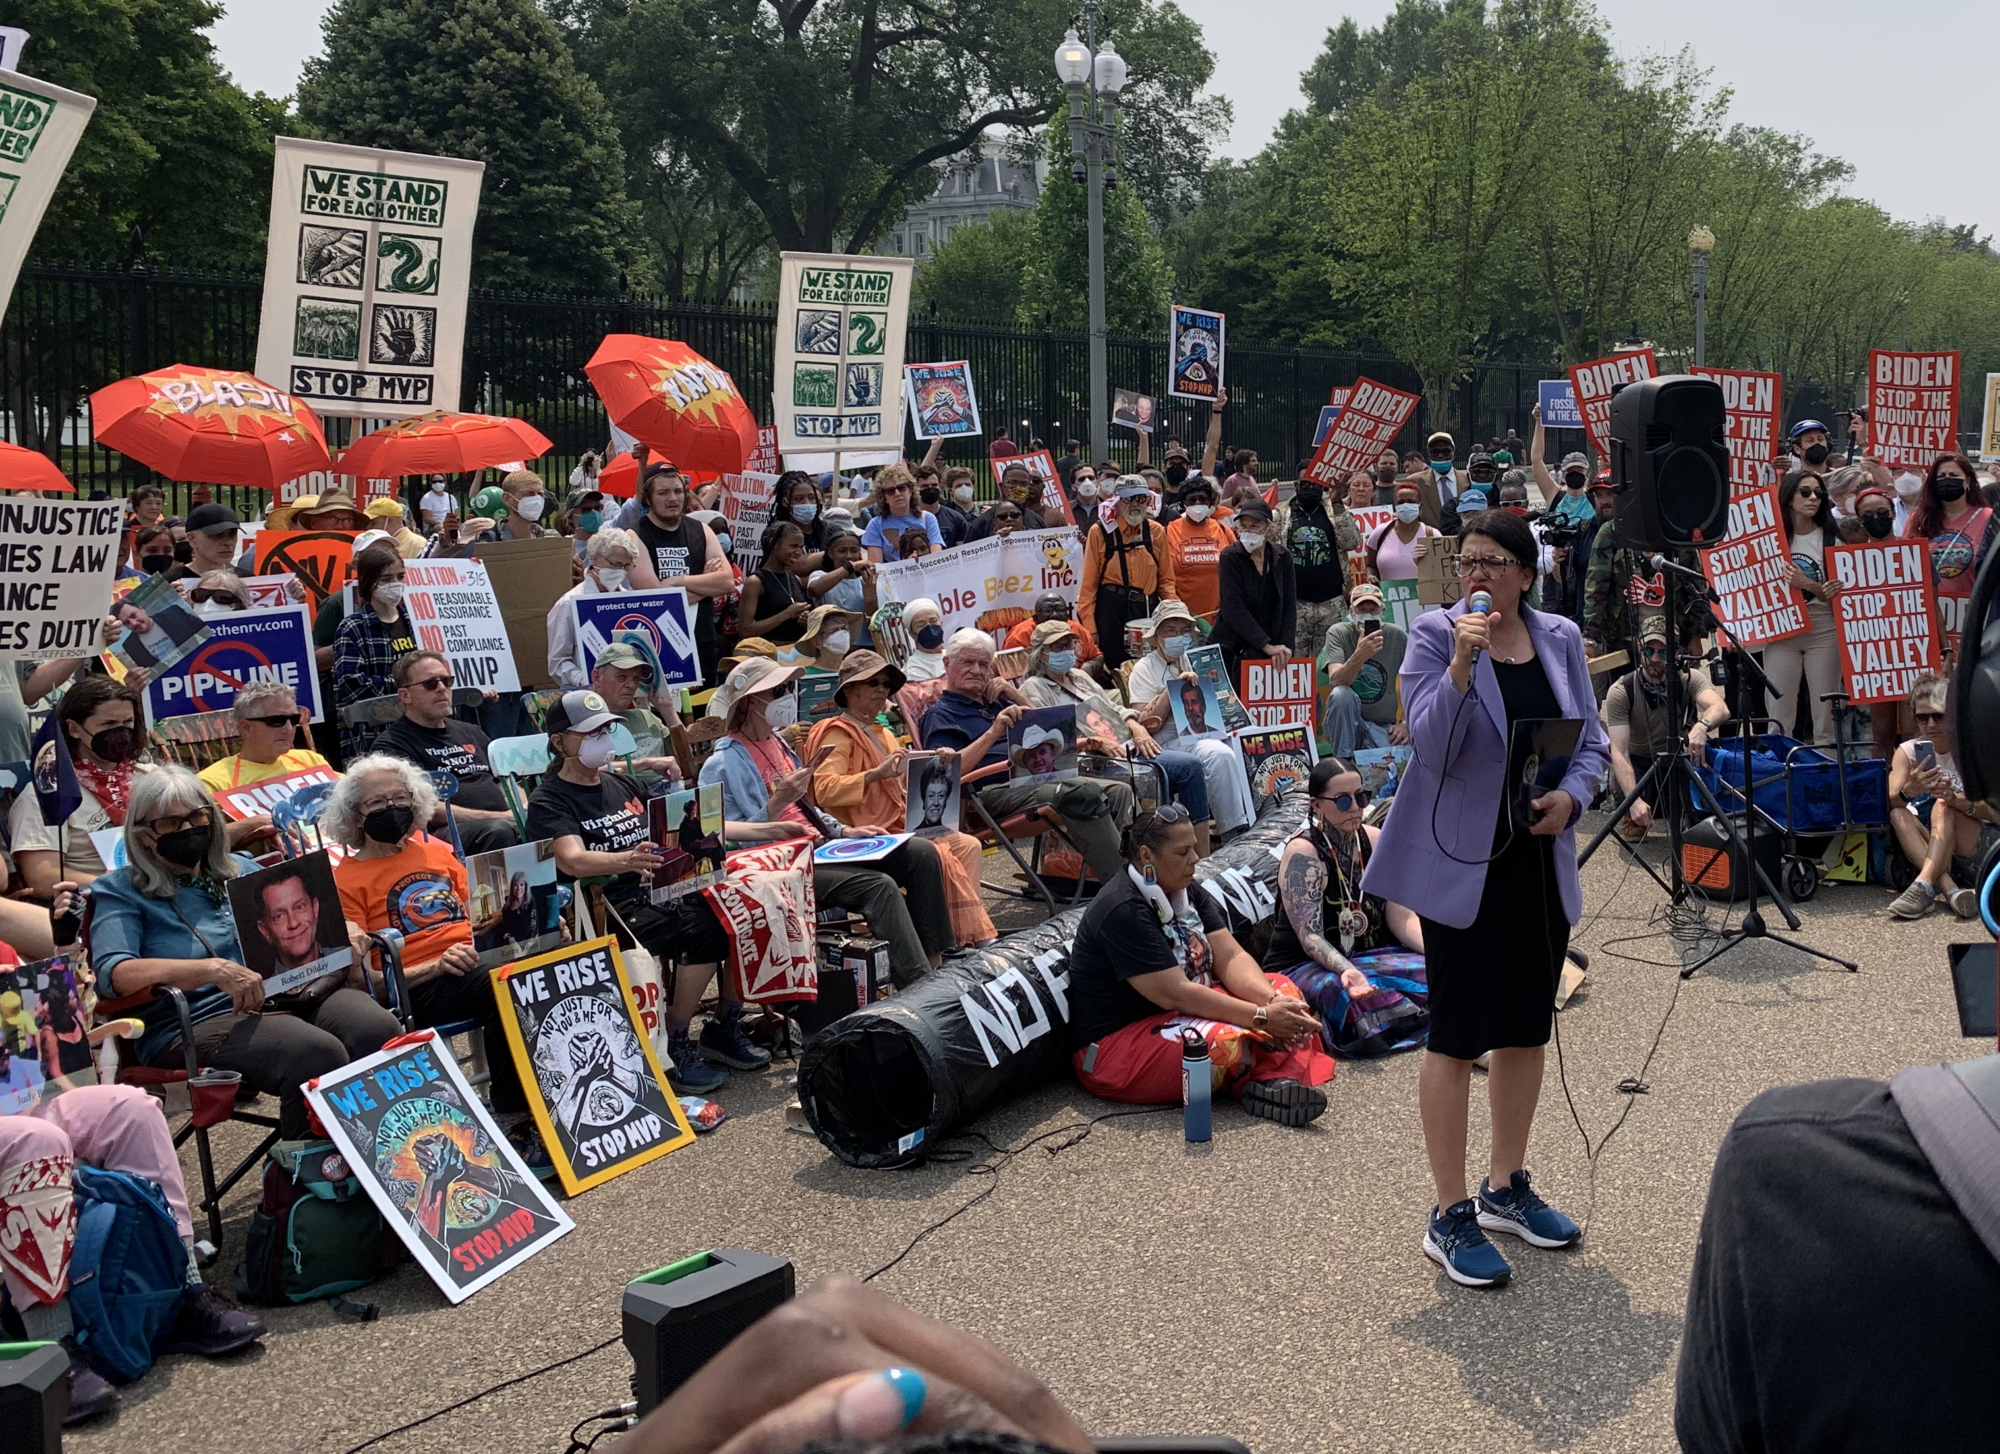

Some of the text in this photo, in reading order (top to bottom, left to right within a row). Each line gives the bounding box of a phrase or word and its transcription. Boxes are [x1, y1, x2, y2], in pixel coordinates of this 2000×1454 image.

[309, 170, 441, 207] WE STAND
[306, 195, 439, 224] FOR EACH OTHER
[805, 271, 889, 292] WE STAND
[802, 288, 886, 304] FOR EACH OTHER
[1178, 312, 1219, 330] WE RISE
[912, 368, 931, 380] WE
[1576, 354, 1651, 400] BIDEN
[1876, 354, 1953, 387] BIDEN
[159, 379, 293, 417] BLAST!
[295, 370, 428, 402] STOP MVP
[1179, 381, 1213, 395] STOP MVP
[1875, 387, 1952, 410] STOP THE
[1350, 382, 1414, 423] BIDEN
[1550, 399, 1577, 410] FOSSIL
[797, 417, 876, 435] STOP MVP
[1340, 412, 1397, 442] STOP THE
[1547, 410, 1571, 421] IN THE
[1874, 406, 1951, 427] MOUNTAIN
[927, 423, 950, 435] STOP
[1741, 417, 1771, 440] THE
[1875, 422, 1950, 450] VALLEY
[1330, 428, 1388, 456] MOUNTAIN
[1322, 443, 1377, 473] VALLEY
[367, 478, 392, 494] THE
[727, 475, 766, 496] VIOLATION
[724, 496, 740, 521] NO
[737, 526, 755, 539] PAST
[51, 544, 110, 573] LAW
[657, 549, 687, 557] STAND
[920, 552, 959, 569] Successful
[961, 538, 1000, 558] Respectful
[1001, 534, 1036, 546] Empowered
[1184, 545, 1200, 553] NEW
[1709, 532, 1783, 575] STOP THE
[660, 559, 684, 568] WITH
[1713, 557, 1788, 595] MOUNTAIN
[1834, 545, 1923, 589] BIDEN
[983, 574, 1034, 603] Beez
[1041, 567, 1079, 590] Inc.
[409, 592, 493, 621] NO REASONABLE
[438, 606, 493, 620] ASSURANCE
[596, 603, 626, 613] protect
[642, 600, 665, 608] water
[1719, 581, 1794, 621] VALLEY
[1841, 589, 1927, 620] STOP THE
[38, 618, 101, 650] DUTY
[1722, 606, 1805, 643] PIPELINE!
[1843, 614, 1929, 643] MOUNTAIN
[418, 625, 468, 654] NO PAST
[446, 638, 506, 653] COMPLIANCE
[39, 648, 87, 659] JEFFERSON
[1847, 637, 1930, 673] VALLEY
[161, 661, 300, 701] PIPELINE
[452, 656, 499, 688] MVP
[1248, 663, 1312, 701] BIDEN
[1248, 704, 1312, 728] STOP THE
[424, 744, 465, 757] Virginia
[1242, 730, 1305, 756] WE RISE
[450, 754, 474, 766] NOT
[1257, 754, 1304, 777] NOT JUST FOR
[581, 808, 634, 832] Virginia
[602, 817, 641, 838] is NOT
[589, 840, 610, 852] for
[736, 846, 795, 871] STOP
[394, 873, 432, 892] PROTECT
[720, 886, 759, 966] SOUTHGATE
[750, 907, 767, 930] NO
[280, 962, 329, 986] Robert Dilday
[511, 951, 611, 1007] WE RISE
[541, 997, 613, 1039] NOT JUST FOR
[554, 1012, 596, 1037] YOU & ME
[17, 1083, 62, 1106] Judy Bonds
[328, 1051, 441, 1120] WE RISE
[376, 1099, 452, 1149] NOT JUST FOR
[392, 1112, 437, 1143] YOU & ME
[580, 1113, 662, 1168] STOP MVP
[323, 1155, 344, 1174] STOP
[452, 1208, 537, 1273] STOP MVP
